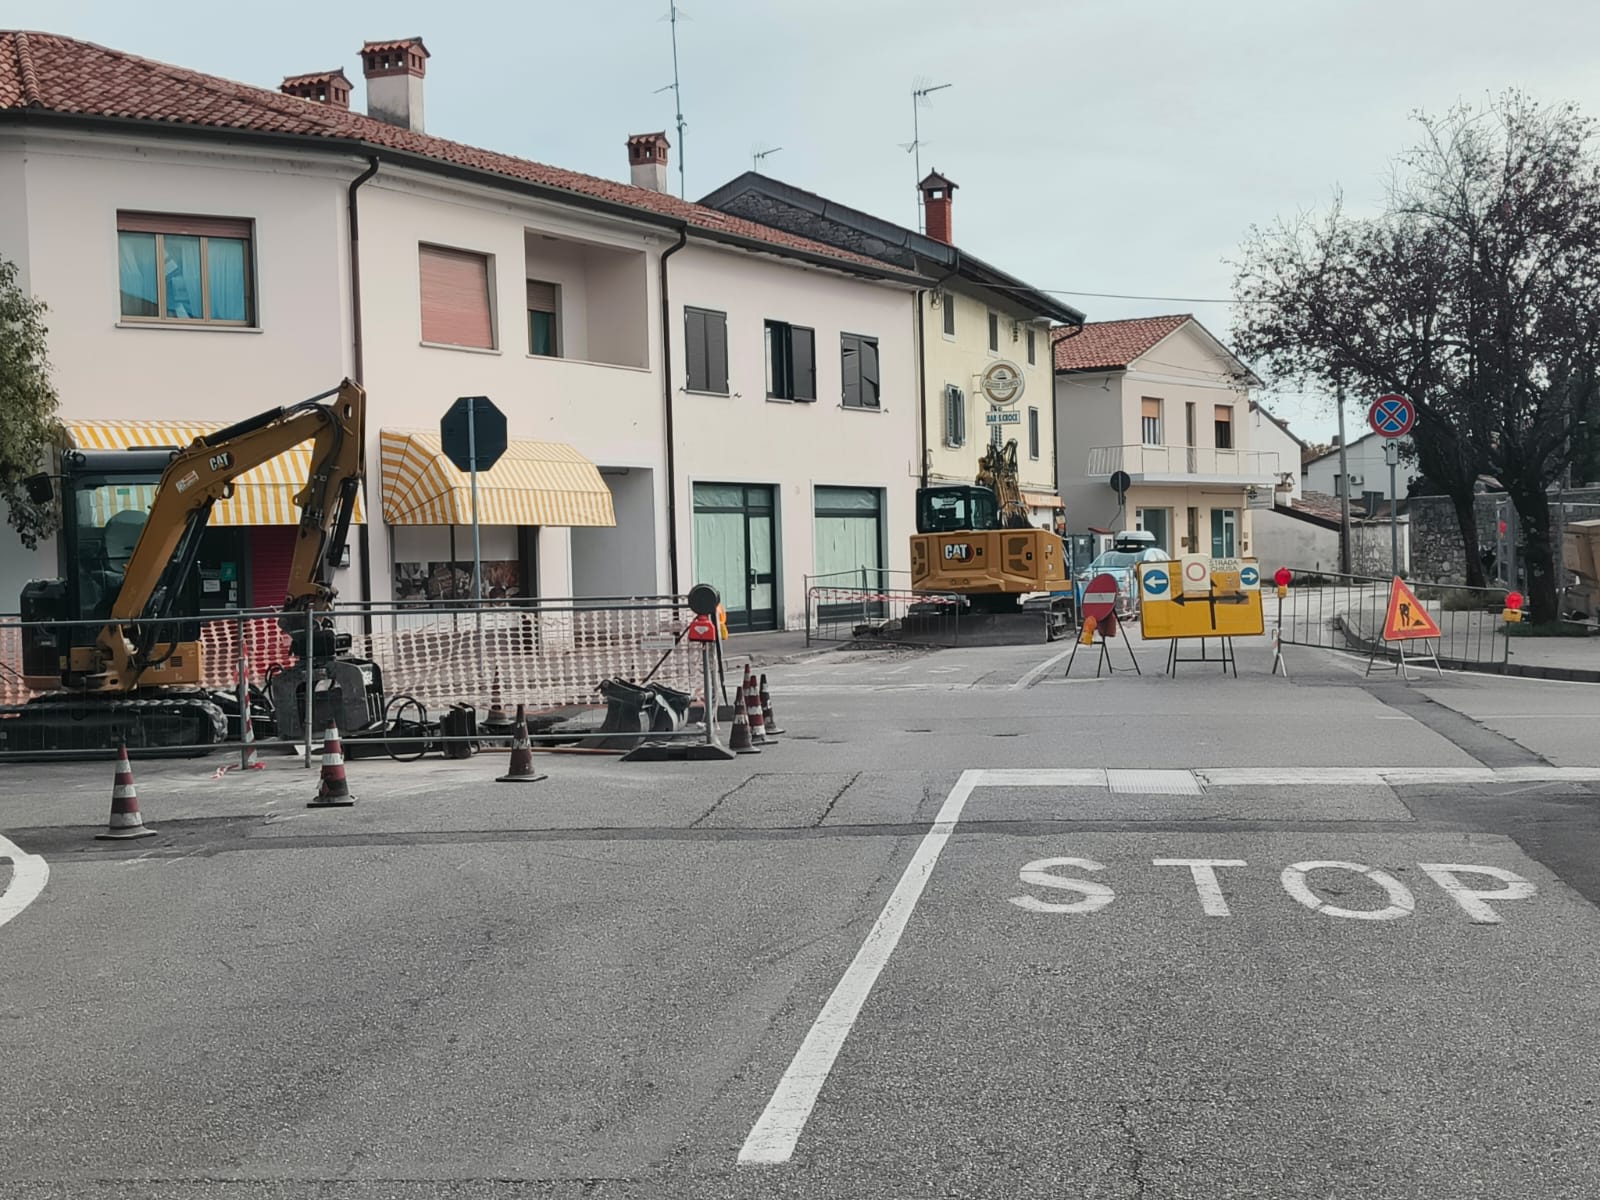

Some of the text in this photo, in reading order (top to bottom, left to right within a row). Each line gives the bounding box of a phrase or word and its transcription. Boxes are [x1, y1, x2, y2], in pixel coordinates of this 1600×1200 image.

[986, 414, 997, 422] BAR
[209, 452, 229, 471] CAT
[944, 544, 968, 560] CAT
[1009, 856, 1538, 924] STOP
